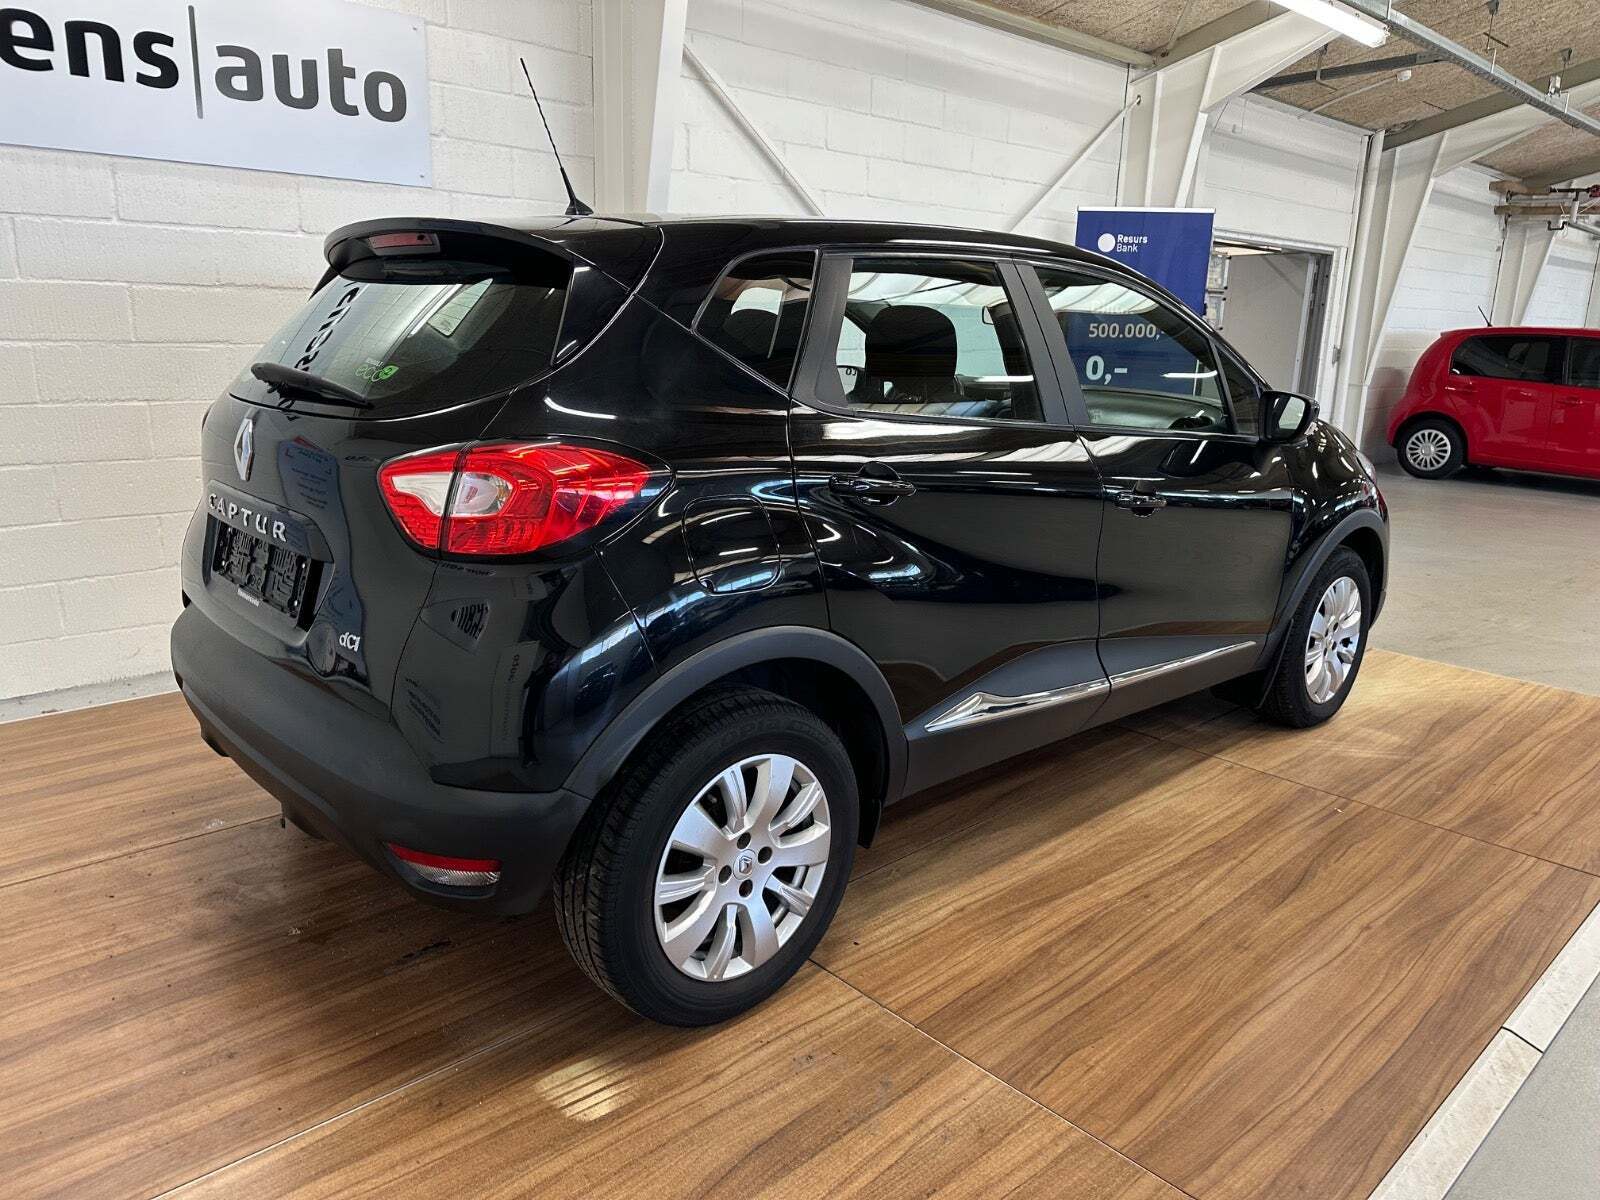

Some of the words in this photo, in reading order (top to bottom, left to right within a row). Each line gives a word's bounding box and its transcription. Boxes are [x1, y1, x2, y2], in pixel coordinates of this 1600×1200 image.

[214, 44, 408, 123] auto
[1116, 243, 1138, 253] Bank
[1117, 234, 1148, 243] Resurs
[1086, 355, 1128, 385] 0,-
[208, 493, 287, 542] CAPTUR
